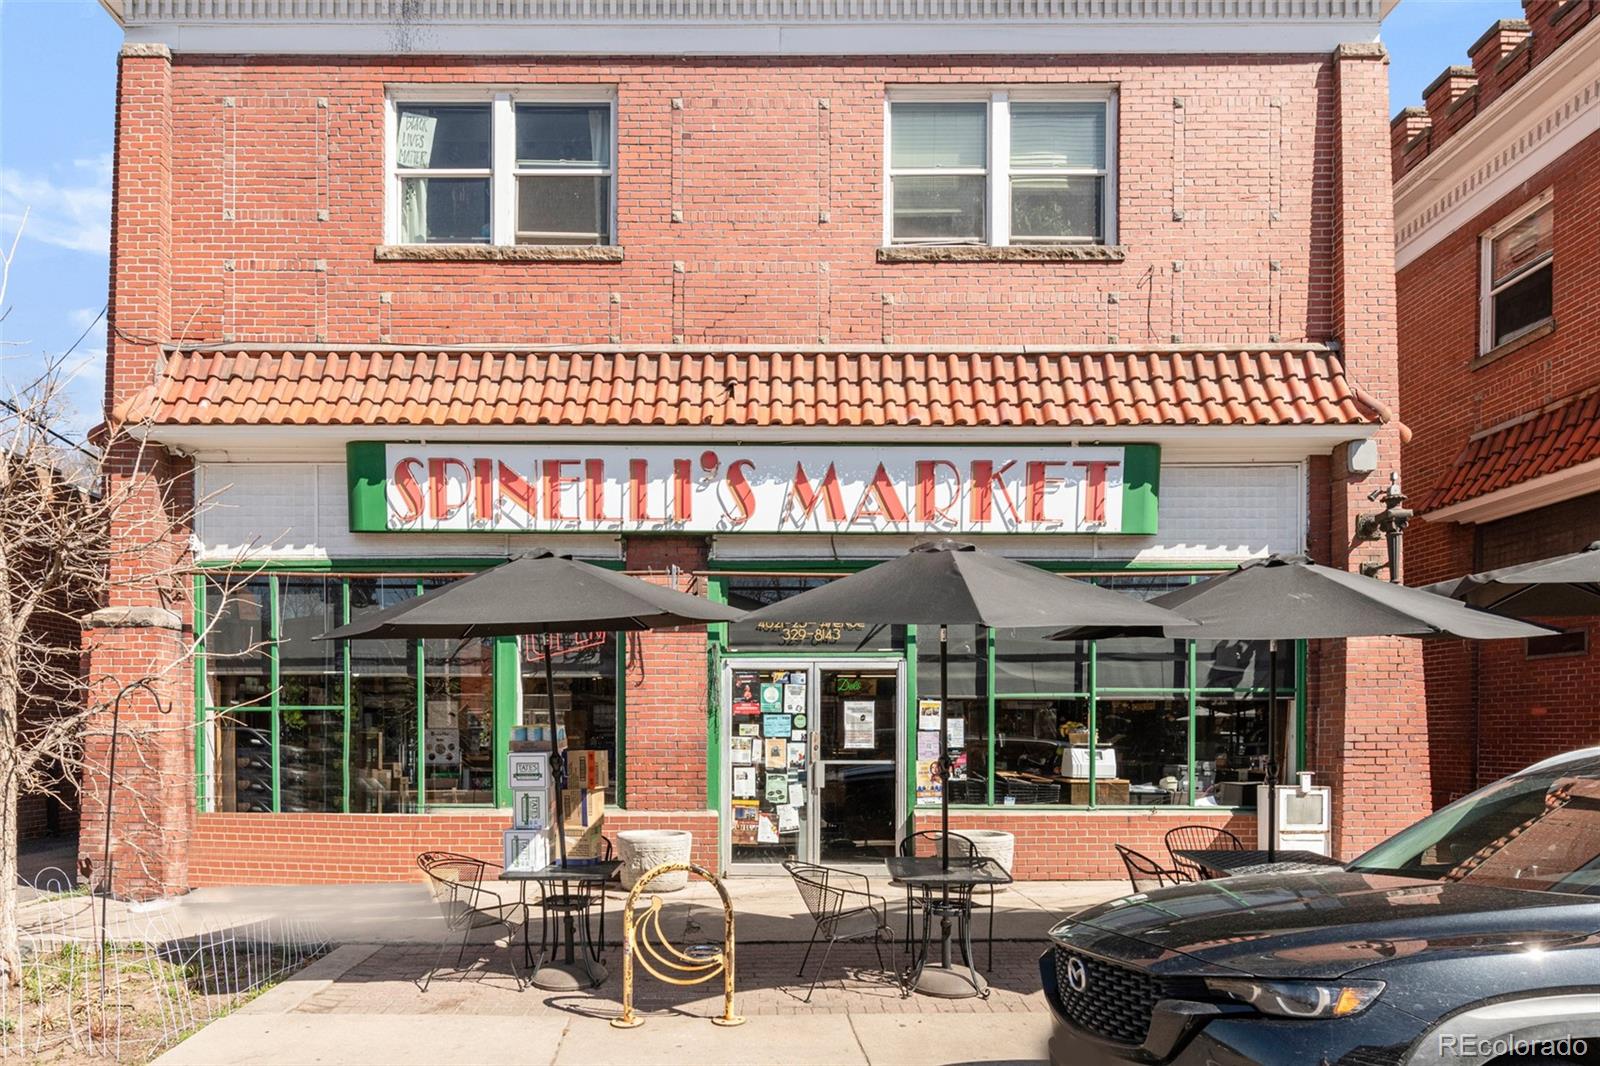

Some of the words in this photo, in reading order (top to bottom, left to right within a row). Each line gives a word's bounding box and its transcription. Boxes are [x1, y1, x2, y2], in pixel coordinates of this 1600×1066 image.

[406, 116, 428, 132] BLACK
[402, 132, 424, 148] LIVES
[398, 149, 428, 168] MATTER
[390, 450, 757, 524] SPINELLI'S
[784, 459, 1121, 526] MARKET
[782, 628, 841, 641] 329-8143
